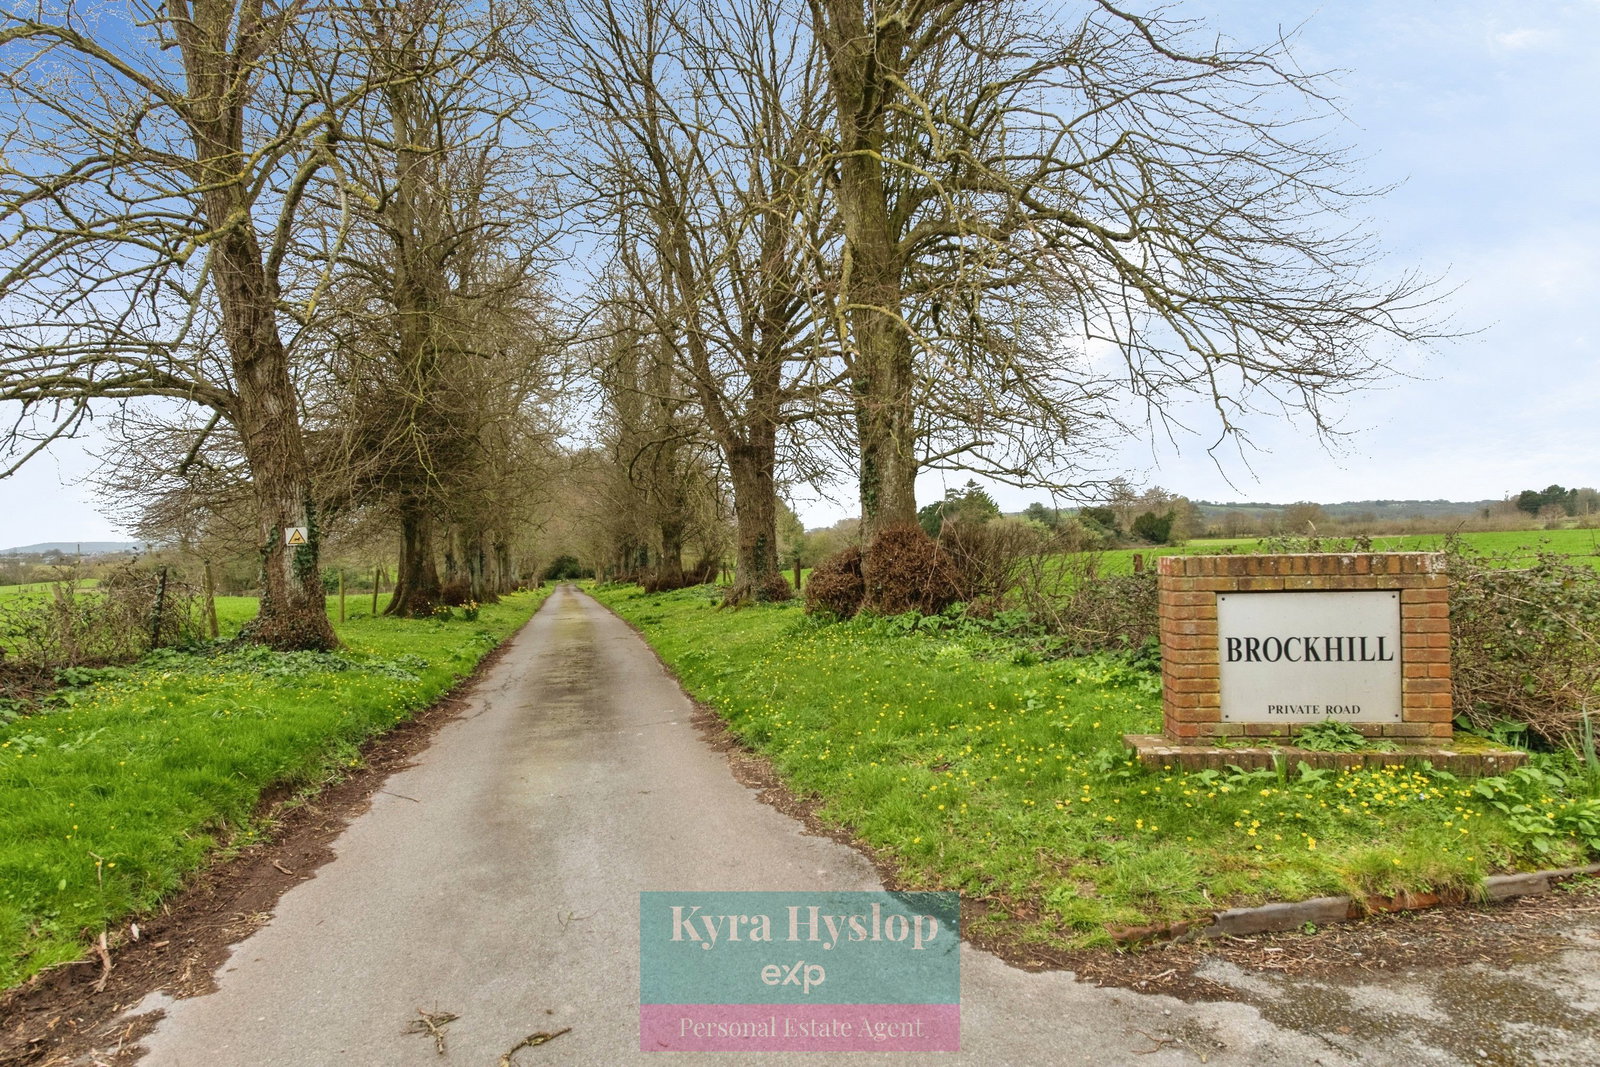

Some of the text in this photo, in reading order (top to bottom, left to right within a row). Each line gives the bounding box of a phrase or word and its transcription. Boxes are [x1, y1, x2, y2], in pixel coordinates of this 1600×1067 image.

[1226, 636, 1394, 662] BROCKHILL
[1267, 704, 1361, 715] PRIVATE ROAD
